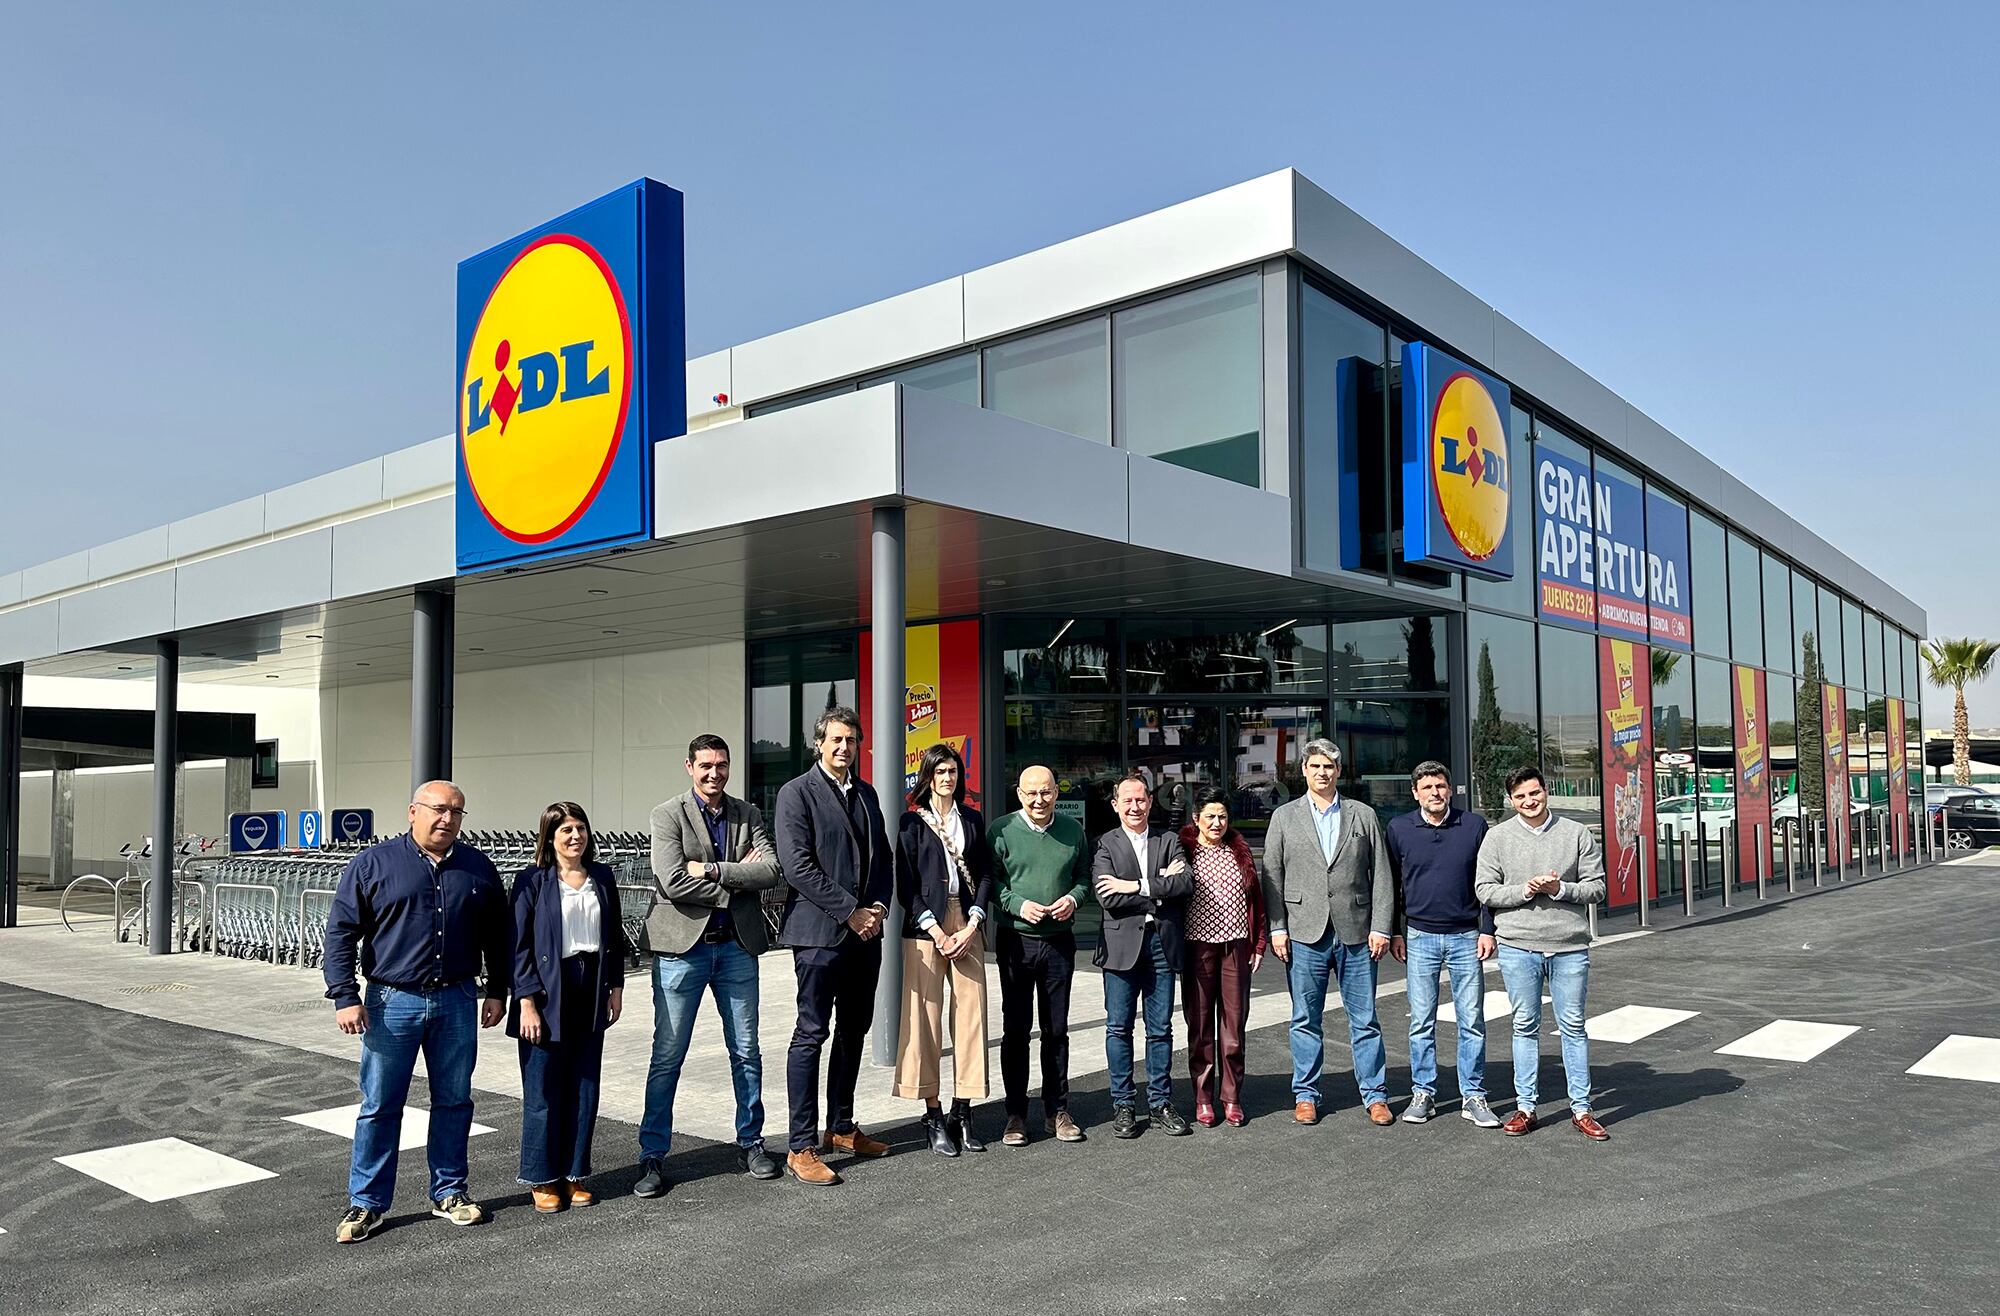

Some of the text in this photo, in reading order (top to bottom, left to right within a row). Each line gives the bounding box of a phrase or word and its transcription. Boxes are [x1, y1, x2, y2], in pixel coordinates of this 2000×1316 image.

[467, 339, 610, 436] LIDL
[1539, 460, 1611, 534] GRAN
[1541, 519, 1679, 607] APERTURA
[1543, 586, 1574, 611] JUEVES
[1601, 603, 1629, 624] ABRIMOS
[1629, 610, 1648, 628] NUEVA
[910, 690, 931, 702] Precio
[911, 703, 934, 720] LIDL
